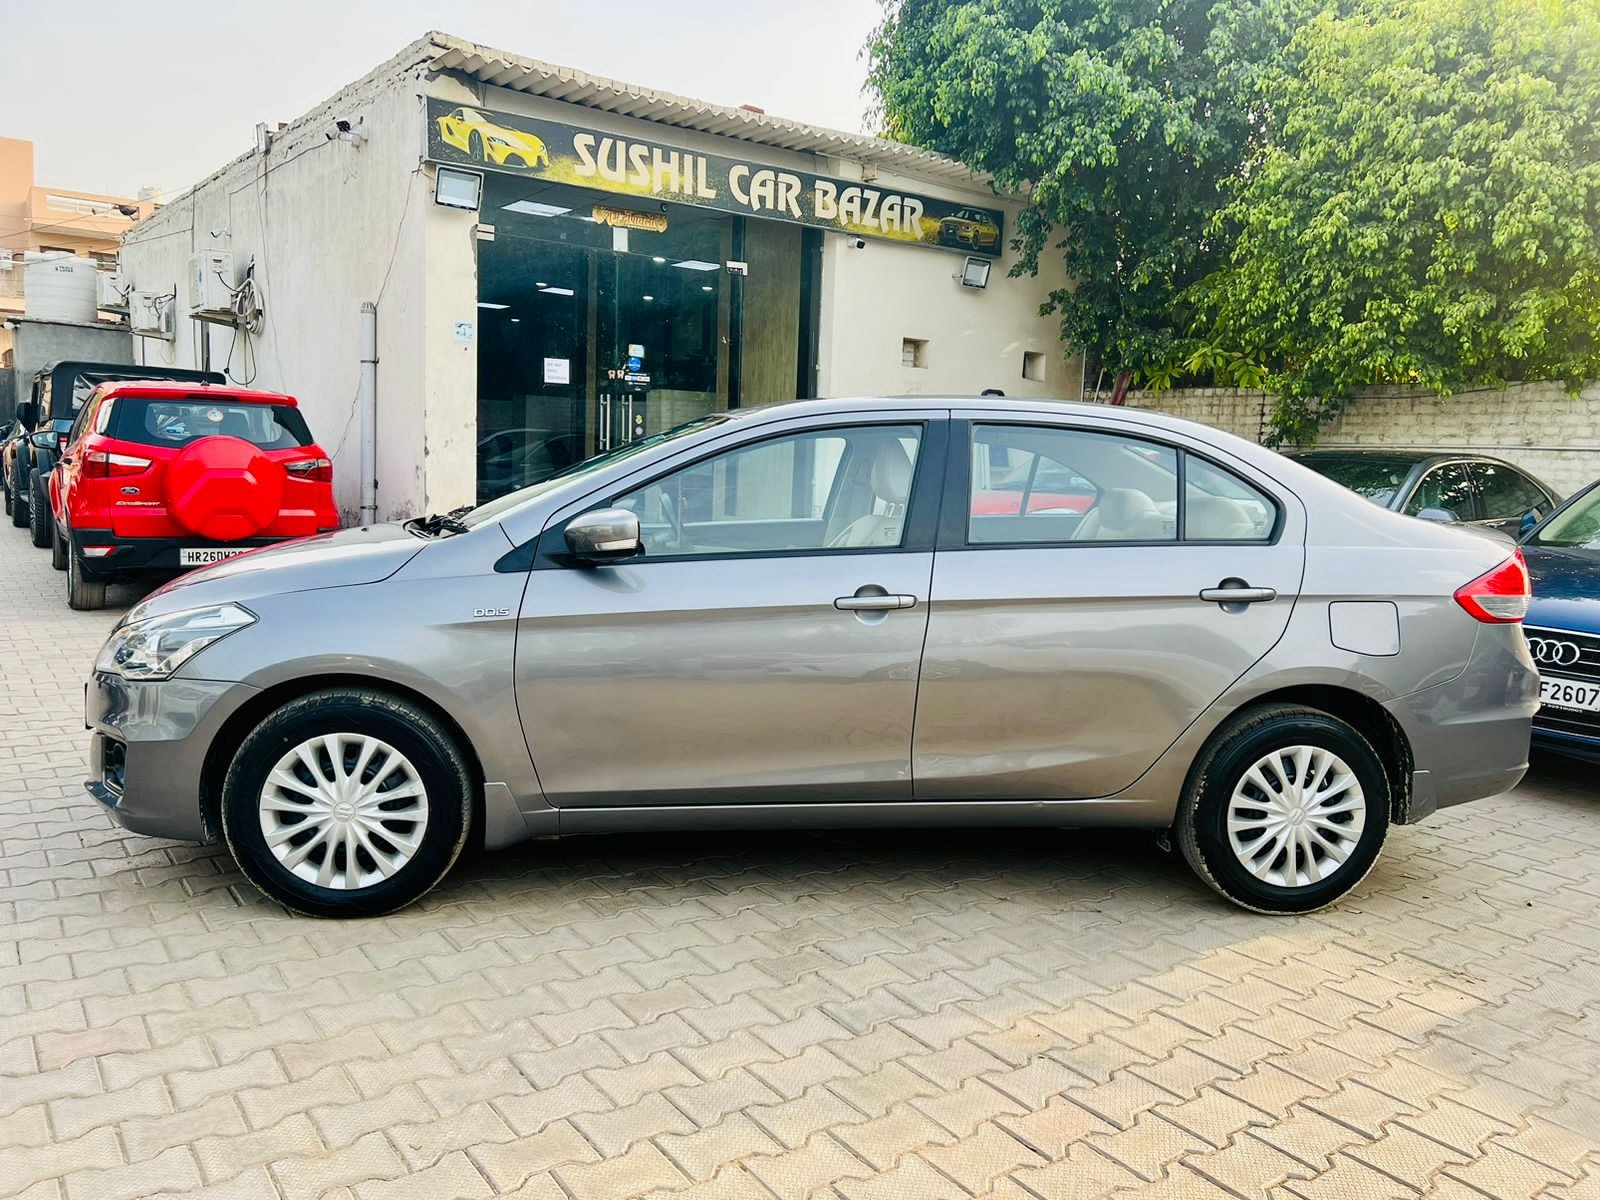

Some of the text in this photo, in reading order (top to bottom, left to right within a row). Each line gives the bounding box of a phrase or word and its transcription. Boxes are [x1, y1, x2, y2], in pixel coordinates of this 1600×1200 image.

[573, 132, 924, 240] SUSHIL CAR BAZAR
